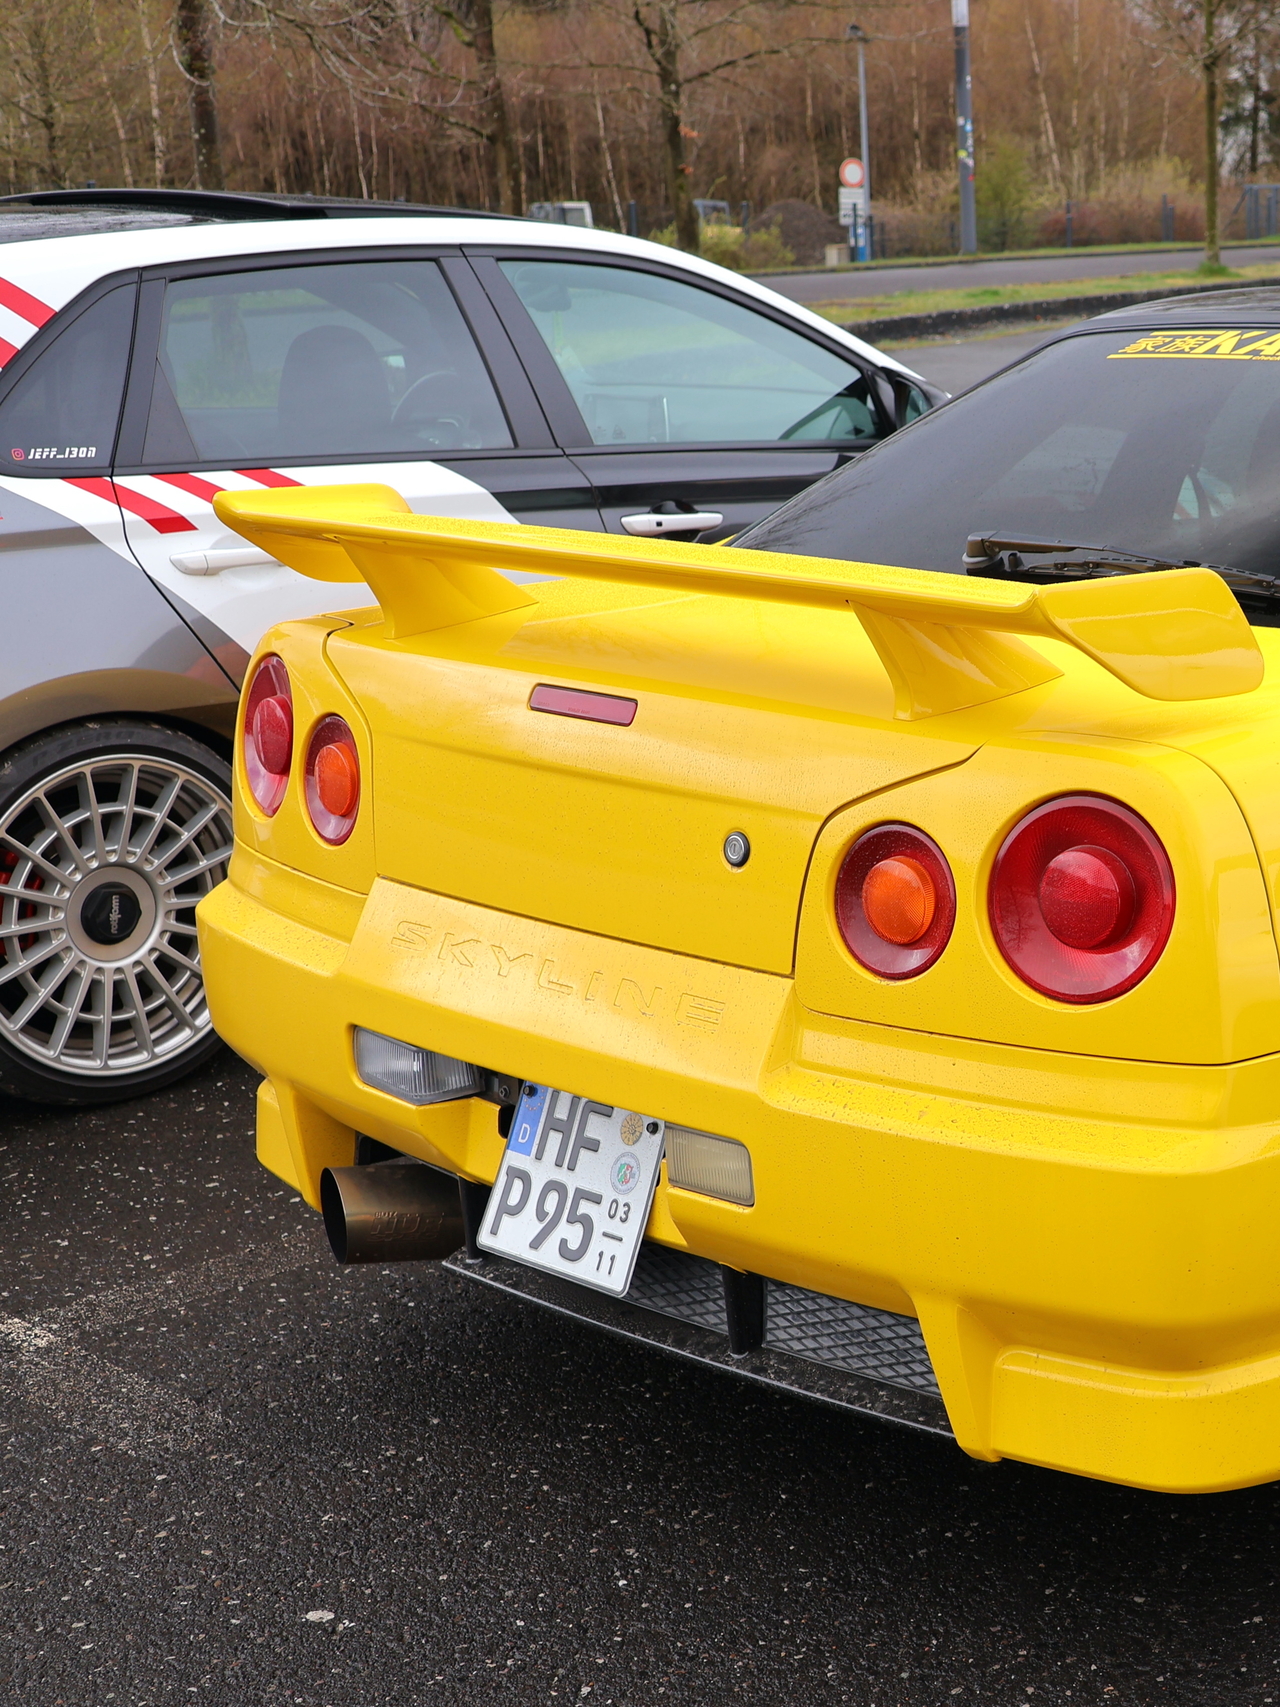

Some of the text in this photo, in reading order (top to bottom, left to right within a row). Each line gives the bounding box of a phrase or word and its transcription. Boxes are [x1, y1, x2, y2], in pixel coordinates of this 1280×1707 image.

[1118, 336, 1211, 354] 家族
[390, 919, 726, 1033] SKYLINE
[517, 1123, 531, 1144] D
[534, 1089, 614, 1172] HF
[607, 1198, 631, 1223] 03
[596, 1250, 616, 1275] 11
